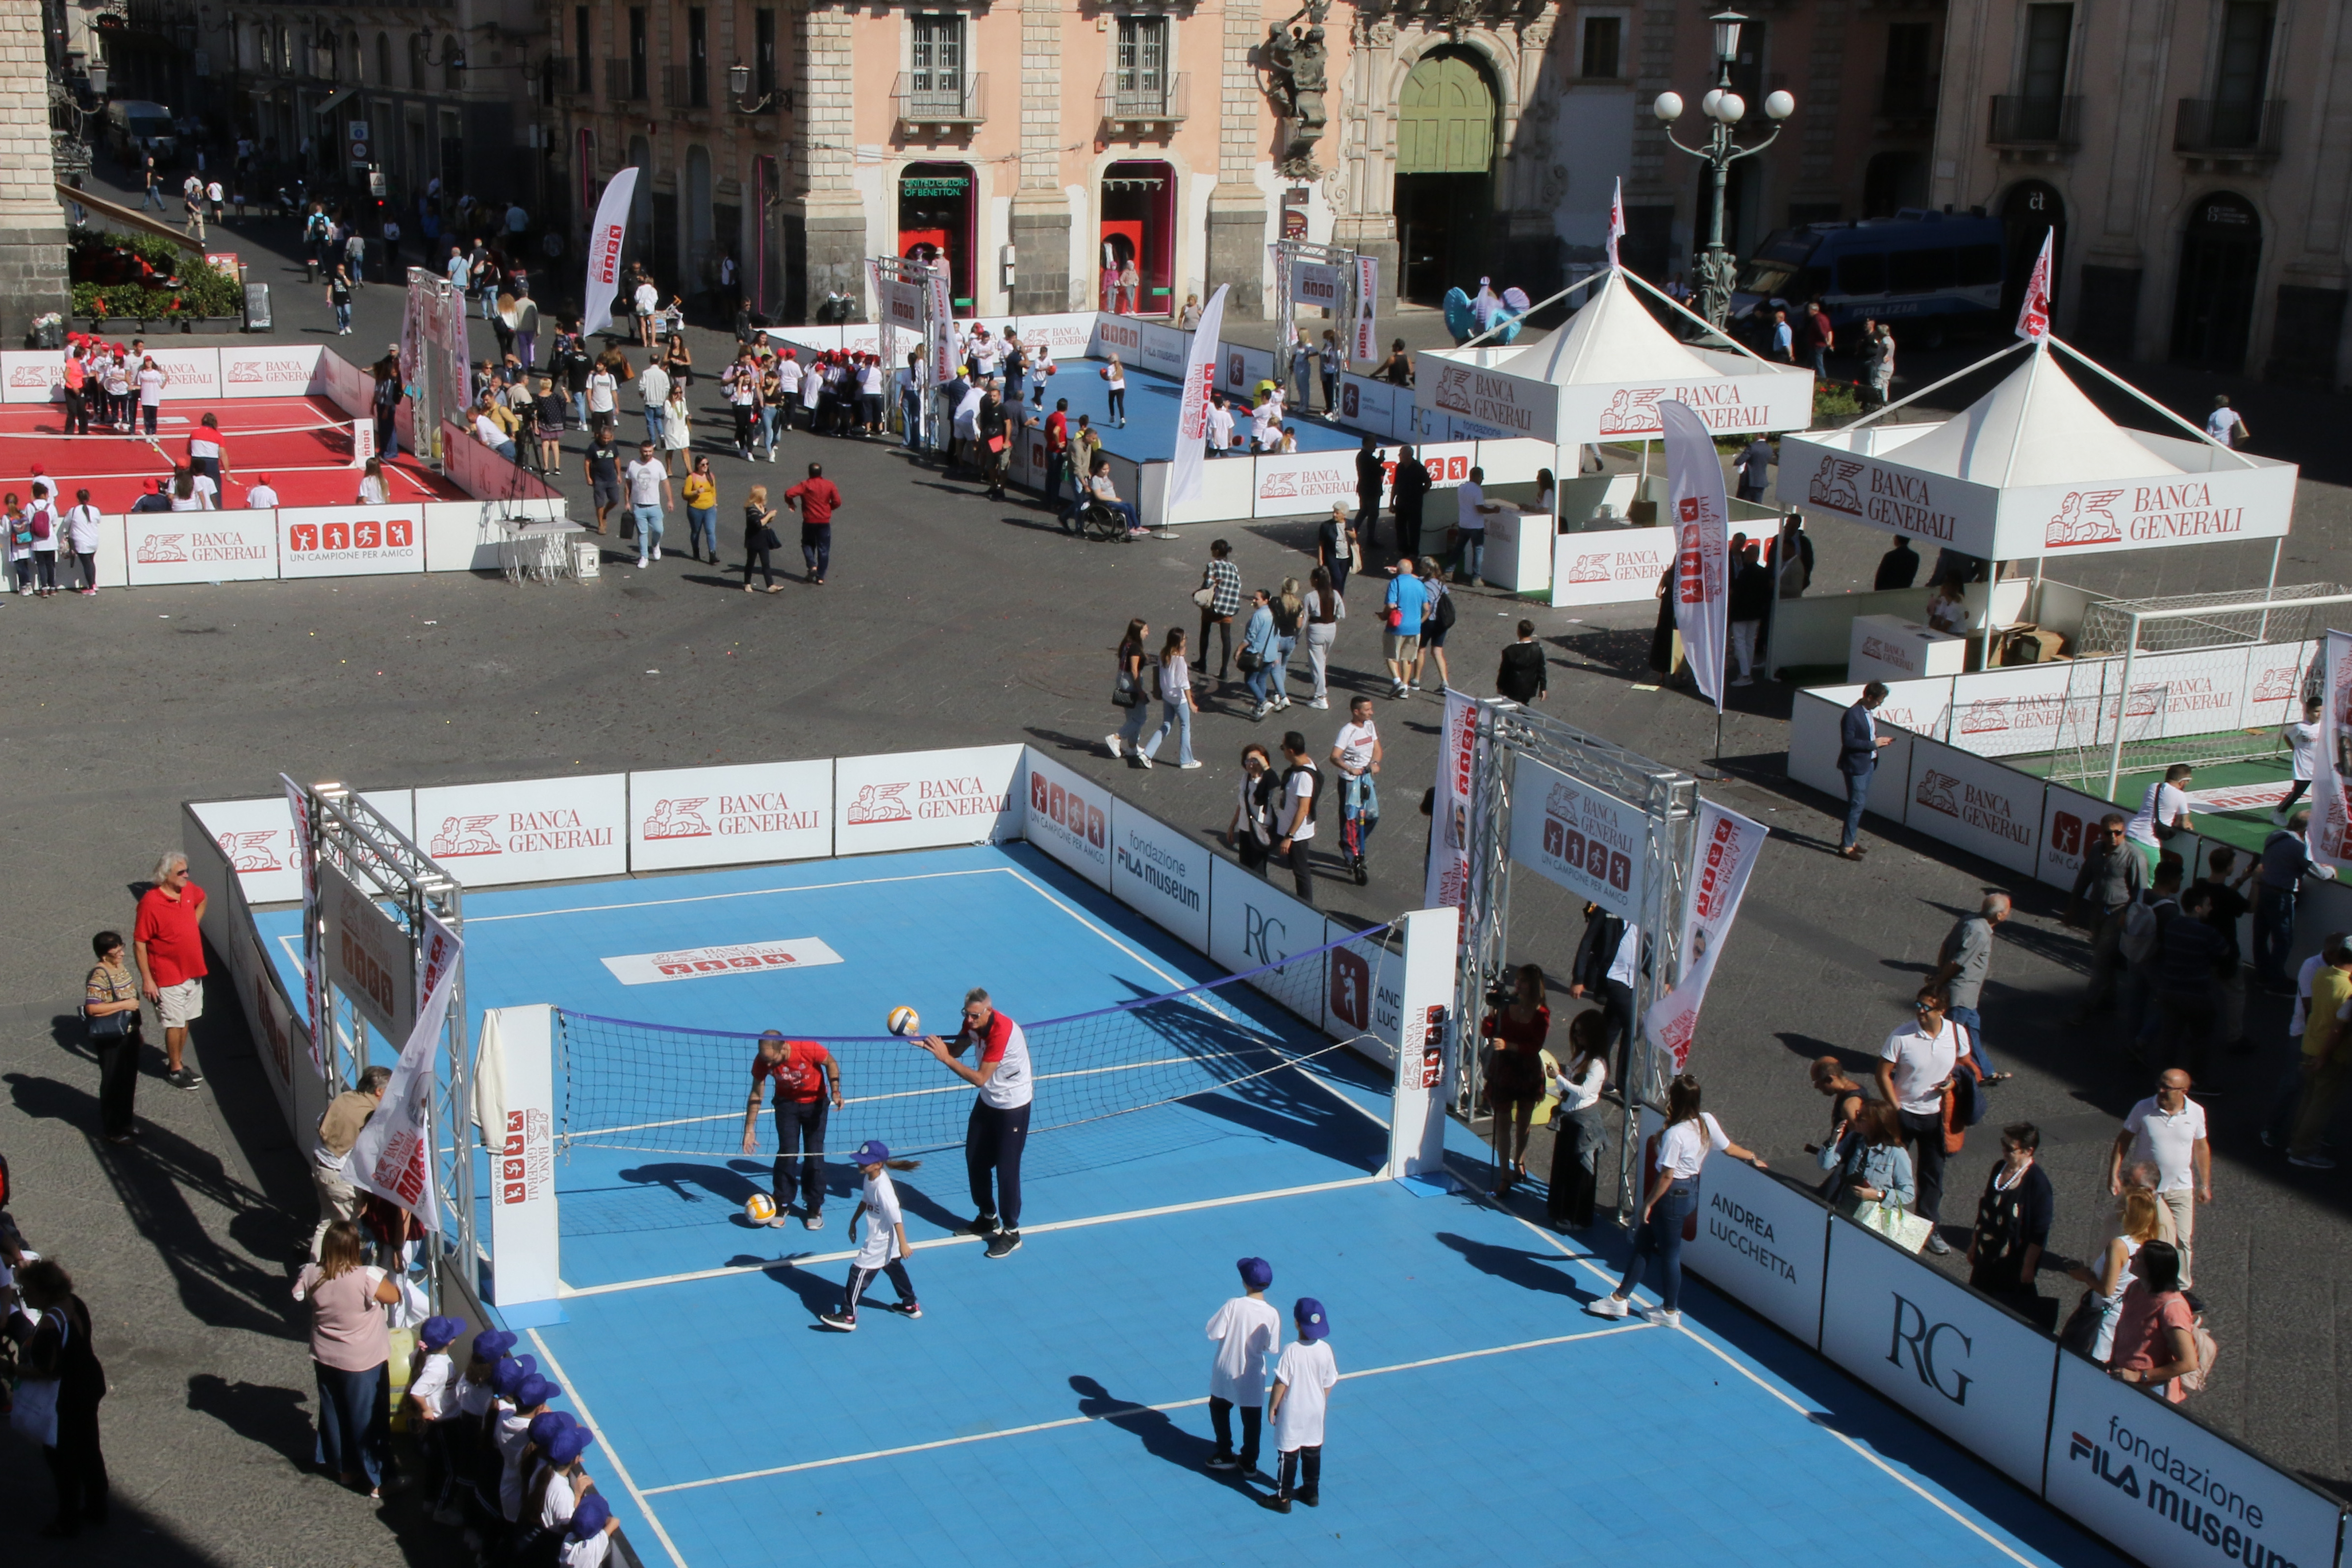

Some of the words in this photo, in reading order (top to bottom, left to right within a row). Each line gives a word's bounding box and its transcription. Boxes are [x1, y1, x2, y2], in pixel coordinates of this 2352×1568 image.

[936, 178, 969, 187] COLORS
[1852, 302, 1918, 318] POLIZIA
[1052, 327, 1081, 336] BANCA
[265, 361, 302, 371] BANCA
[265, 370, 318, 382] GENERALI
[1185, 377, 1193, 407] BANCA
[1193, 364, 1203, 408] GENERALI
[1475, 374, 1515, 404] BANCA
[1675, 383, 1743, 406] BANCA
[1474, 398, 1532, 431] GENERALI
[1463, 419, 1501, 438] fondazione
[1301, 480, 1357, 496] GENERALI
[1302, 469, 1341, 484] BANCA
[1870, 467, 1930, 506] BANCA
[2132, 482, 2213, 513] BANCA
[1868, 497, 1956, 541] GENERALI
[2129, 507, 2245, 541] GENERALI
[191, 531, 245, 547] BANCA
[192, 546, 267, 563] GENERALI
[290, 554, 305, 562] UN
[307, 552, 359, 561] CAMPIONE
[362, 551, 379, 559] PER
[380, 548, 414, 558] AMICO
[1616, 550, 1659, 566] BANCA
[1883, 653, 1914, 671] GENERALI
[1884, 643, 1906, 659] BANCA
[2165, 677, 2213, 696] BANCA
[2016, 691, 2068, 712] BANCA
[2163, 692, 2232, 713] GENERALI
[1874, 708, 1914, 724] ANCA
[2014, 707, 2087, 730] GENERALI
[919, 776, 986, 799] BANCA
[718, 792, 788, 815] BANCA
[918, 793, 1012, 820] GENERALI
[1583, 796, 1618, 828] BANCA
[1965, 784, 2011, 819] BANCA
[509, 809, 581, 833] BANCA
[718, 810, 819, 836] GENERALI
[1581, 815, 1633, 854] GENERALI
[1963, 805, 2031, 846] GENERALI
[508, 827, 613, 854] GENERALI
[1031, 811, 1040, 824] UN
[1040, 817, 1072, 844] CAMPIONE
[1071, 835, 1083, 852] PER
[1083, 845, 1105, 865] AMICO
[1130, 830, 1186, 878] fondazione
[2049, 851, 2063, 865] UN
[1117, 846, 1143, 878] FILA
[1145, 862, 1200, 912] museum
[1439, 870, 1452, 905] BANCA
[1541, 853, 1552, 867] UN
[1553, 860, 1589, 886] CAMPIONE
[1590, 880, 1602, 892] PER
[1603, 886, 1628, 906] AMICO
[704, 945, 758, 955] BANCA
[708, 947, 785, 960] GENERALI
[766, 961, 802, 970] AMICO
[1404, 1021, 1416, 1057] BANCA
[1415, 1007, 1425, 1056] GENERALI
[383, 1131, 405, 1159] BANCA
[527, 1147, 538, 1201] GENERALI
[539, 1146, 550, 1184] BANCA
[1711, 1192, 1776, 1243] ANDREA
[1709, 1217, 1796, 1285] LUCCHETTA
[1885, 1290, 1973, 1406] RG
[2070, 1431, 2141, 1499] FILA
[2108, 1415, 2264, 1529] fondazione
